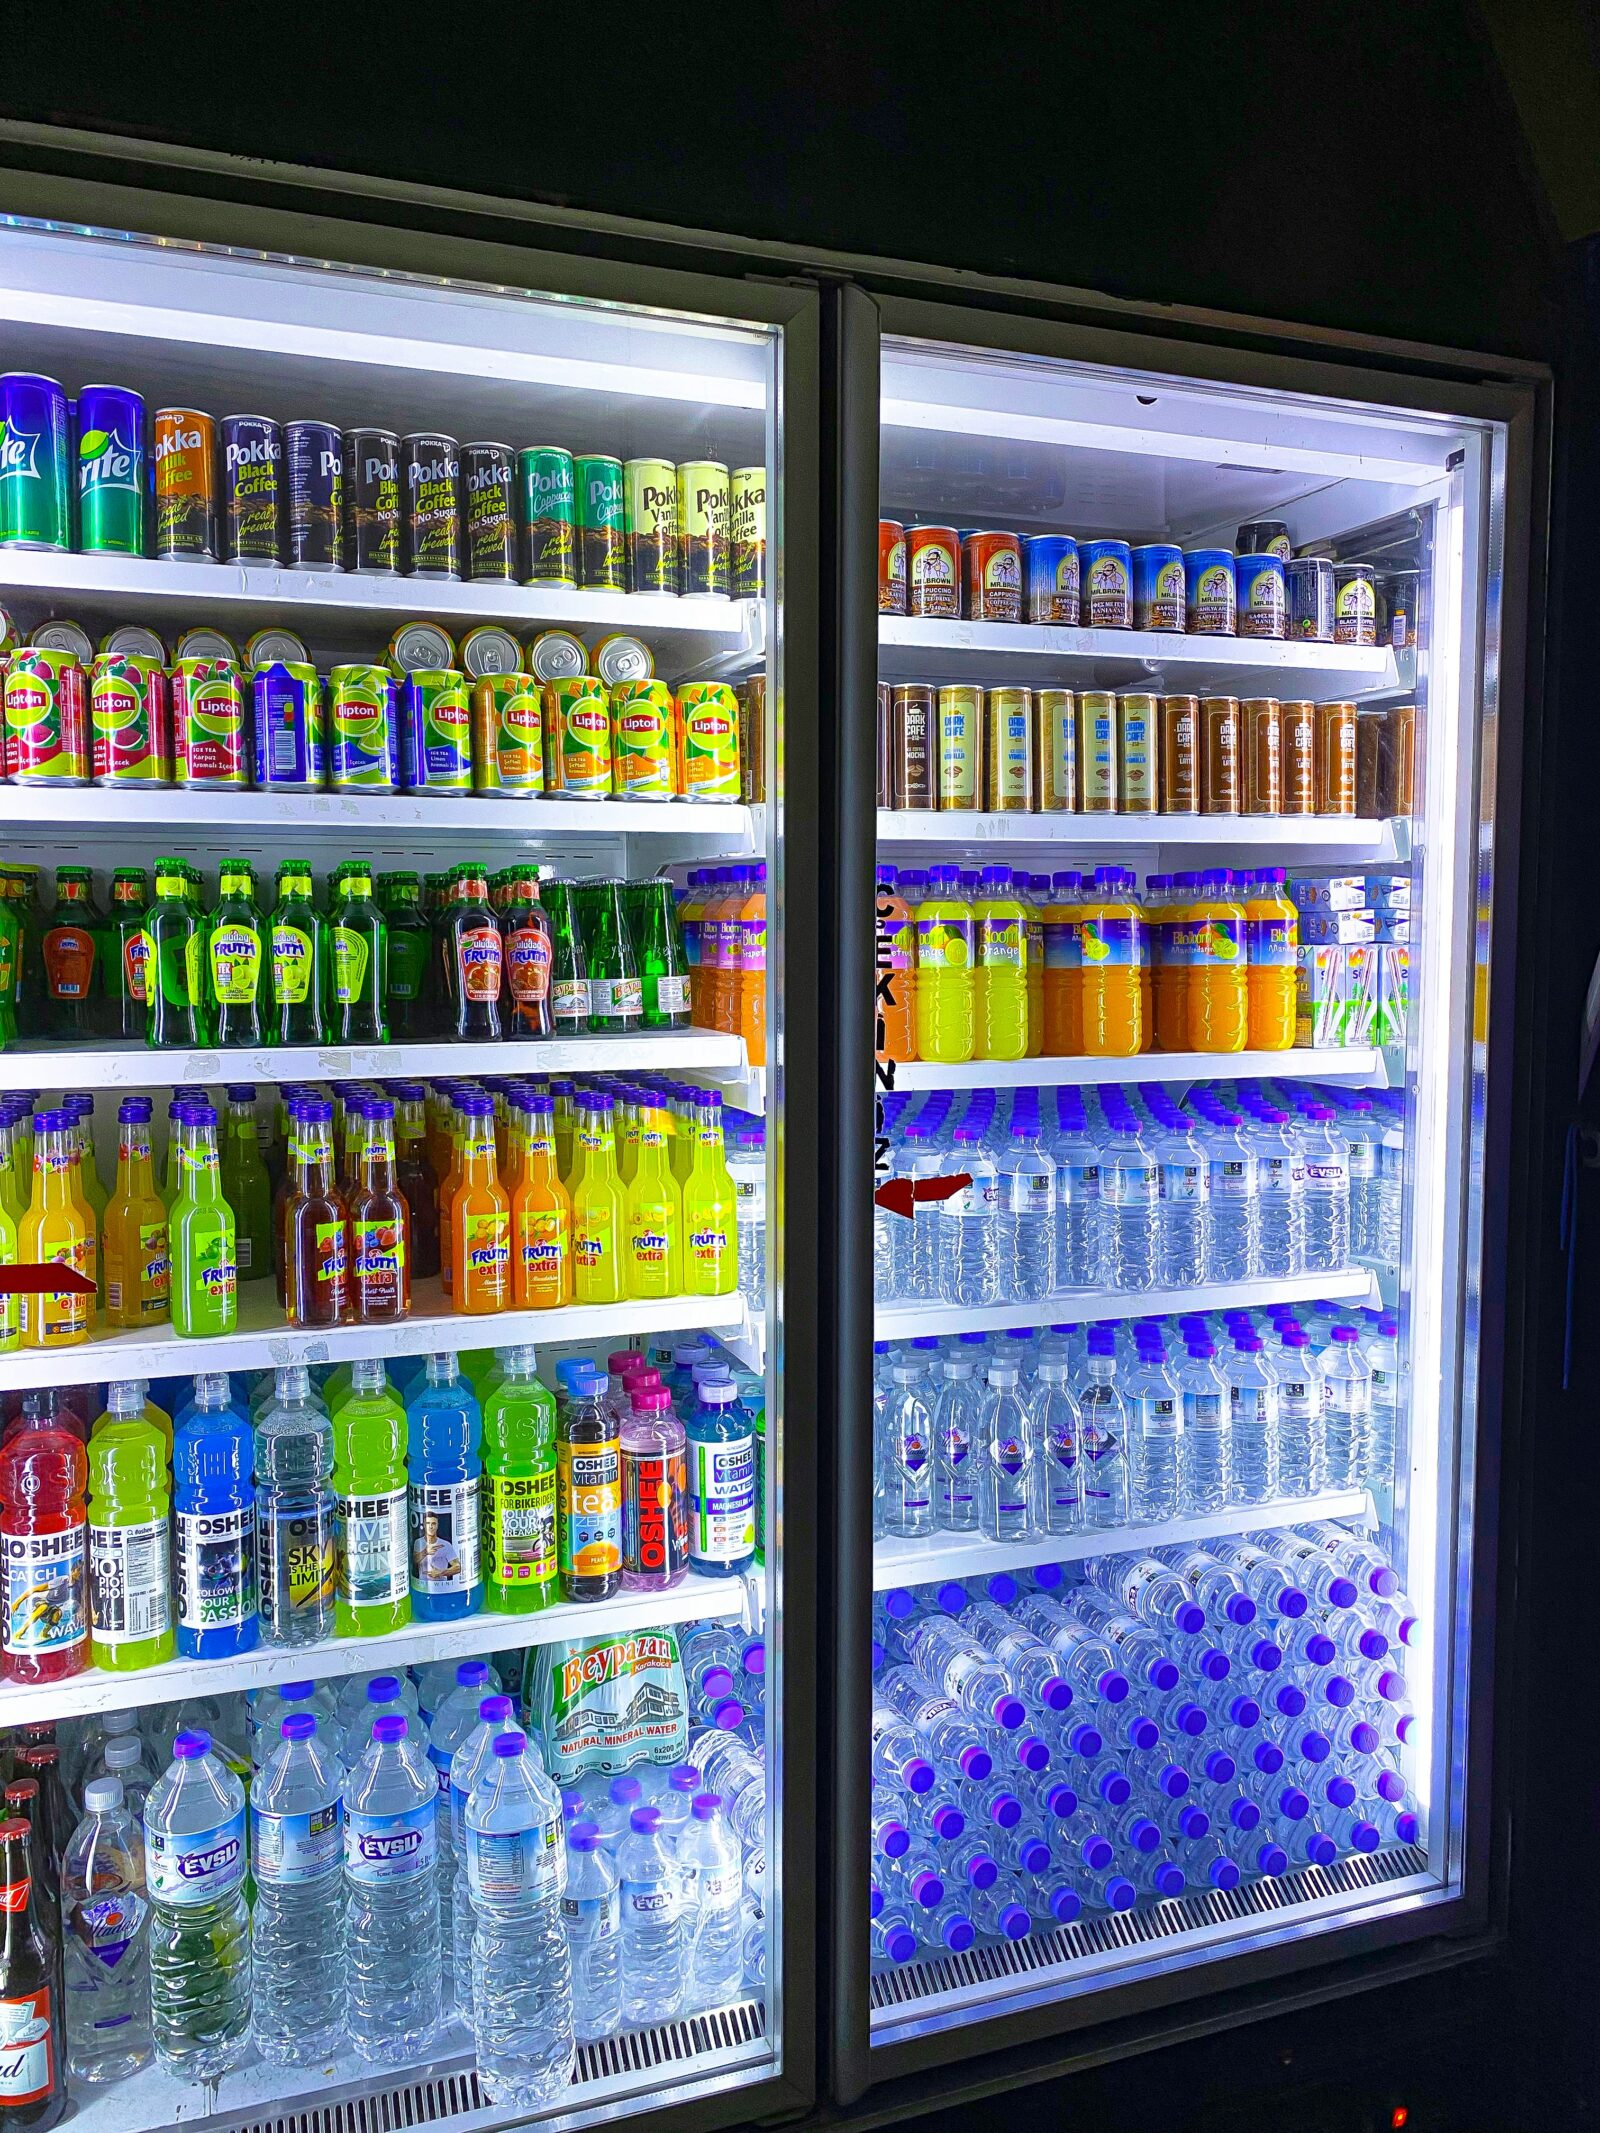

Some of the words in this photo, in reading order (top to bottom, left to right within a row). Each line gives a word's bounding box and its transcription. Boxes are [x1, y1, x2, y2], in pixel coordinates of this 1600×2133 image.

[226, 439, 281, 472] Pokka
[238, 461, 275, 481] Black
[408, 457, 459, 489] Pokka
[234, 479, 278, 497] Coffee
[420, 479, 453, 497] Black
[470, 485, 502, 504] Black
[416, 495, 456, 513] Coffee
[417, 513, 431, 524] No
[433, 508, 457, 519] Sugar
[481, 513, 507, 525] Sugar
[913, 587, 952, 595] CAPPUCCINO
[7, 691, 42, 706] Lipton
[94, 698, 131, 710] Lipton
[200, 700, 239, 715] Lipton
[338, 703, 375, 718] Lipton
[438, 709, 469, 722] Lipton
[511, 713, 540, 725] Lipton
[576, 715, 606, 728] Lipton
[906, 715, 925, 725] DARK
[944, 716, 965, 726] DARK
[623, 719, 659, 731] Lipton
[694, 720, 728, 732] Lipton
[906, 726, 925, 736] CAFE
[944, 726, 964, 736] CAFE
[907, 751, 925, 759] MOCHA
[979, 926, 1019, 944] Bloom
[214, 941, 256, 958] FRUTTI
[978, 946, 1019, 960] Orange
[509, 949, 547, 966] FRUTTI
[367, 1154, 385, 1162] extra
[532, 1150, 549, 1158] extra
[1310, 1167, 1341, 1177] EVSU
[632, 1235, 669, 1250] FRUTTI
[689, 1233, 727, 1248] FRUTTI
[472, 1246, 508, 1264] FRUTTI
[522, 1245, 562, 1264] FRUTTI
[636, 1250, 663, 1261] extra
[694, 1248, 721, 1259] extra
[356, 1255, 397, 1274] FRUTTI
[479, 1262, 506, 1275] extra
[528, 1260, 558, 1272] extra
[361, 1270, 392, 1284] extra
[210, 1281, 235, 1296] extra
[60, 1298, 86, 1310] extra
[576, 1457, 616, 1472] OSHEE
[718, 1450, 752, 1467] OSHEE
[573, 1469, 618, 1485] vitamin
[501, 1474, 555, 1496] OSHEE
[572, 1491, 617, 1516] tea
[712, 1498, 748, 1511] MAGNESIUM
[640, 1460, 665, 1568] OSHEE
[195, 1512, 254, 1535] OSHEE
[10, 1530, 83, 1559] OSHEE
[10, 1568, 57, 1582] CATCH
[177, 1517, 187, 1619] OSHEE
[259, 1519, 274, 1622] OSHEE
[299, 1562, 317, 1573] THE
[99, 1576, 124, 1588] PIO!
[99, 1588, 124, 1599] PIO!
[562, 1636, 671, 1703] Beypazarı
[561, 1736, 602, 1754] NATURAL
[604, 1729, 644, 1746] MINERAL
[646, 1723, 678, 1736] WATER
[364, 1834, 418, 1857] EVSU
[184, 1841, 237, 1875] EVSU
